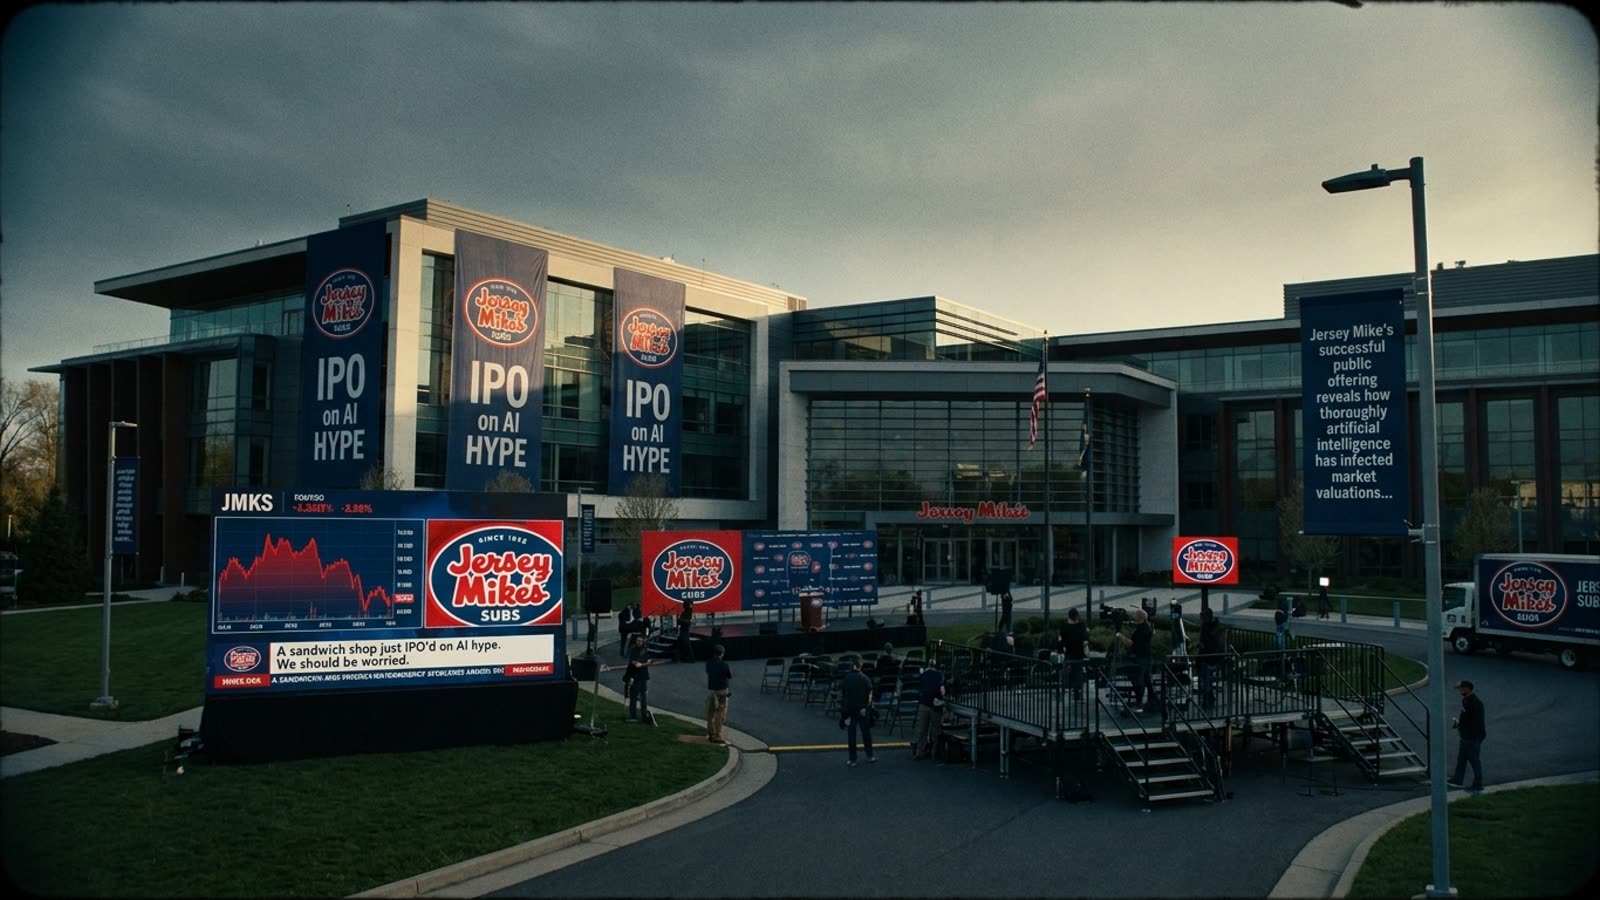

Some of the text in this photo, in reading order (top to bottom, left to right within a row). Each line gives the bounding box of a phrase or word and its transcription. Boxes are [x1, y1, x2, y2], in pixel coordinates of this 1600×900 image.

[1310, 324, 1394, 342] Jersey Mike's
[1319, 340, 1385, 356] successful
[1333, 358, 1371, 373] public
[317, 353, 365, 400] IPO
[470, 361, 528, 408] IPO
[1328, 374, 1378, 389] offering
[626, 379, 670, 421] IPO
[1316, 389, 1390, 403] reveals how
[323, 403, 357, 425] on AI
[478, 412, 519, 432] on AI
[1320, 405, 1387, 422] thoroughly
[631, 424, 664, 442] on AI
[1326, 421, 1380, 434] artificial
[314, 429, 365, 460] HYPE
[466, 435, 527, 467] HYPE
[1317, 438, 1391, 454] intelligence
[623, 445, 670, 473] HYPE
[1315, 452, 1393, 467] has infected
[1332, 470, 1377, 483] market
[1316, 486, 1393, 499] valuations...
[221, 493, 273, 512] JMKS
[447, 543, 553, 582] Jersey
[481, 609, 520, 621] SUBS
[276, 640, 501, 657] A sandwich shop just IPO'd on AI hype.
[277, 655, 409, 669] We should be worried.
